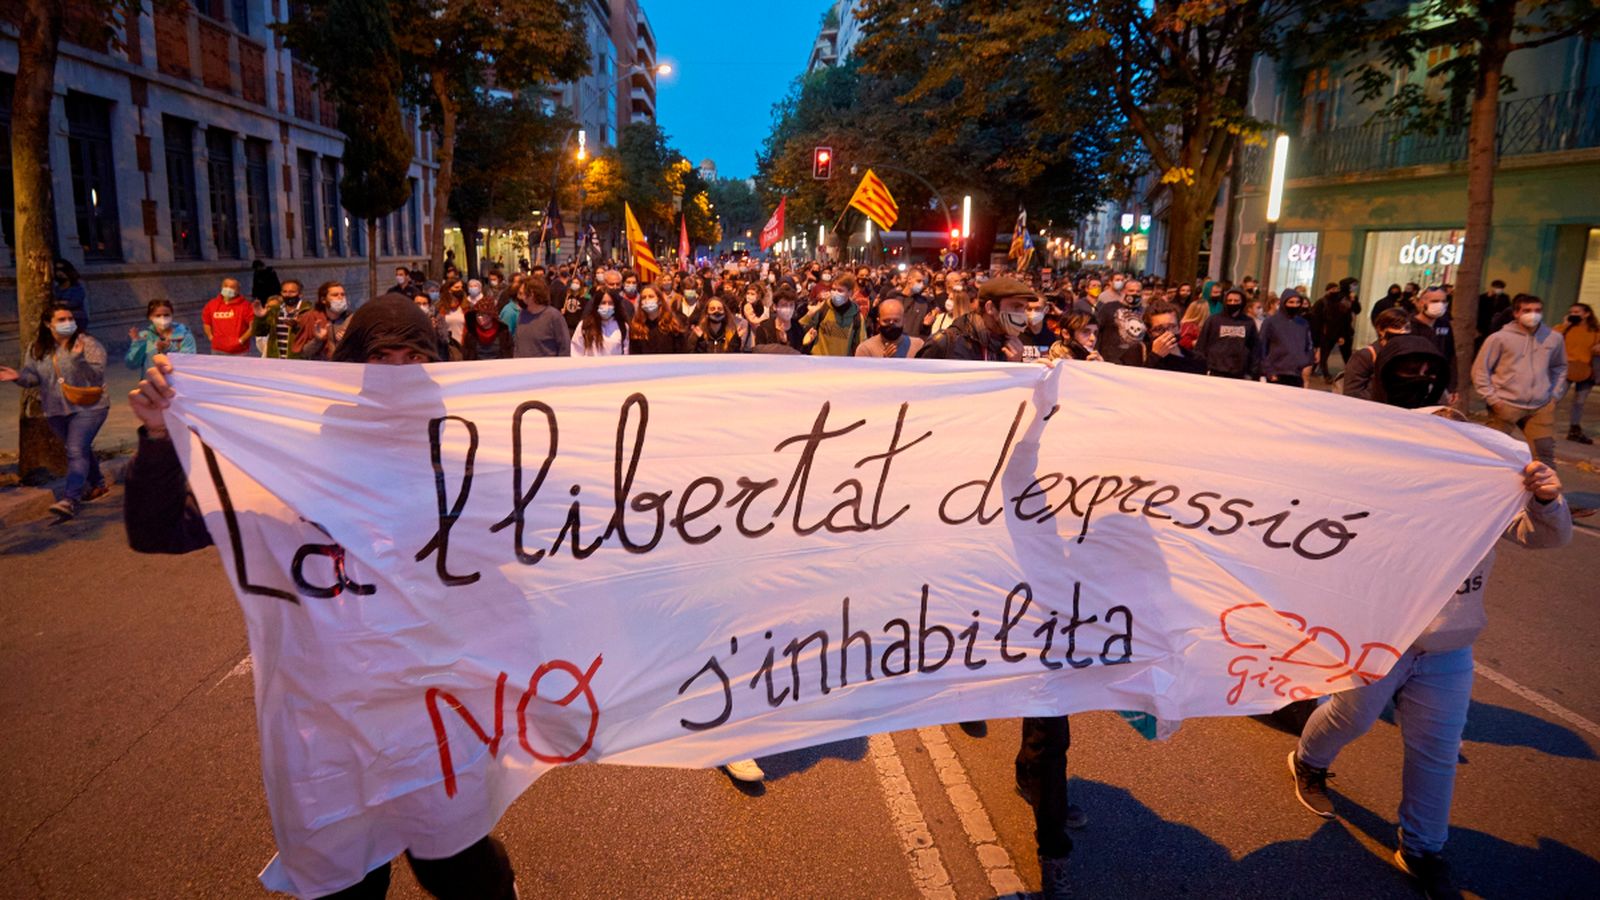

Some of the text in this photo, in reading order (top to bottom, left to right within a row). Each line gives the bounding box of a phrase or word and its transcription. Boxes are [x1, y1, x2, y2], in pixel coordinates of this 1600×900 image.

[187, 391, 1371, 606] La llibertat d'expressió
[425, 653, 603, 799] NO
